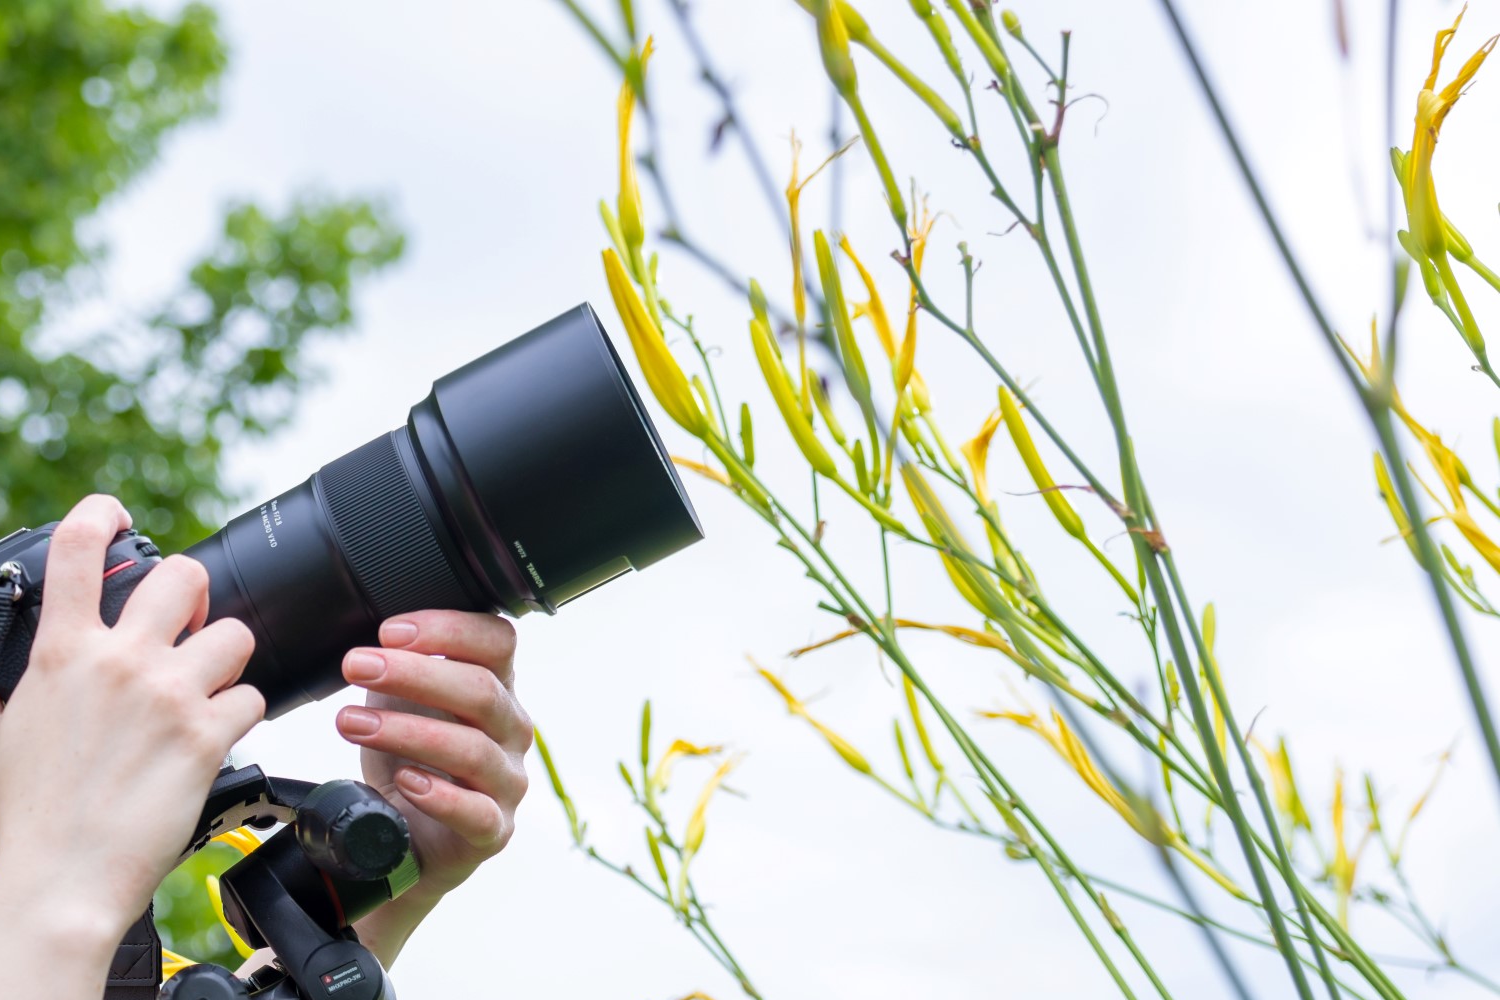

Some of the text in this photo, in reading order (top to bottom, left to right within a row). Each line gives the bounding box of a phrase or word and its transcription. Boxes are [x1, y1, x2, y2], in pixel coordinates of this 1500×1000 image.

[262, 514, 273, 534] MACRO
[268, 533, 278, 548] VXD
[526, 562, 545, 588] TAMRON
[328, 973, 362, 992] MHXPRO-3W
